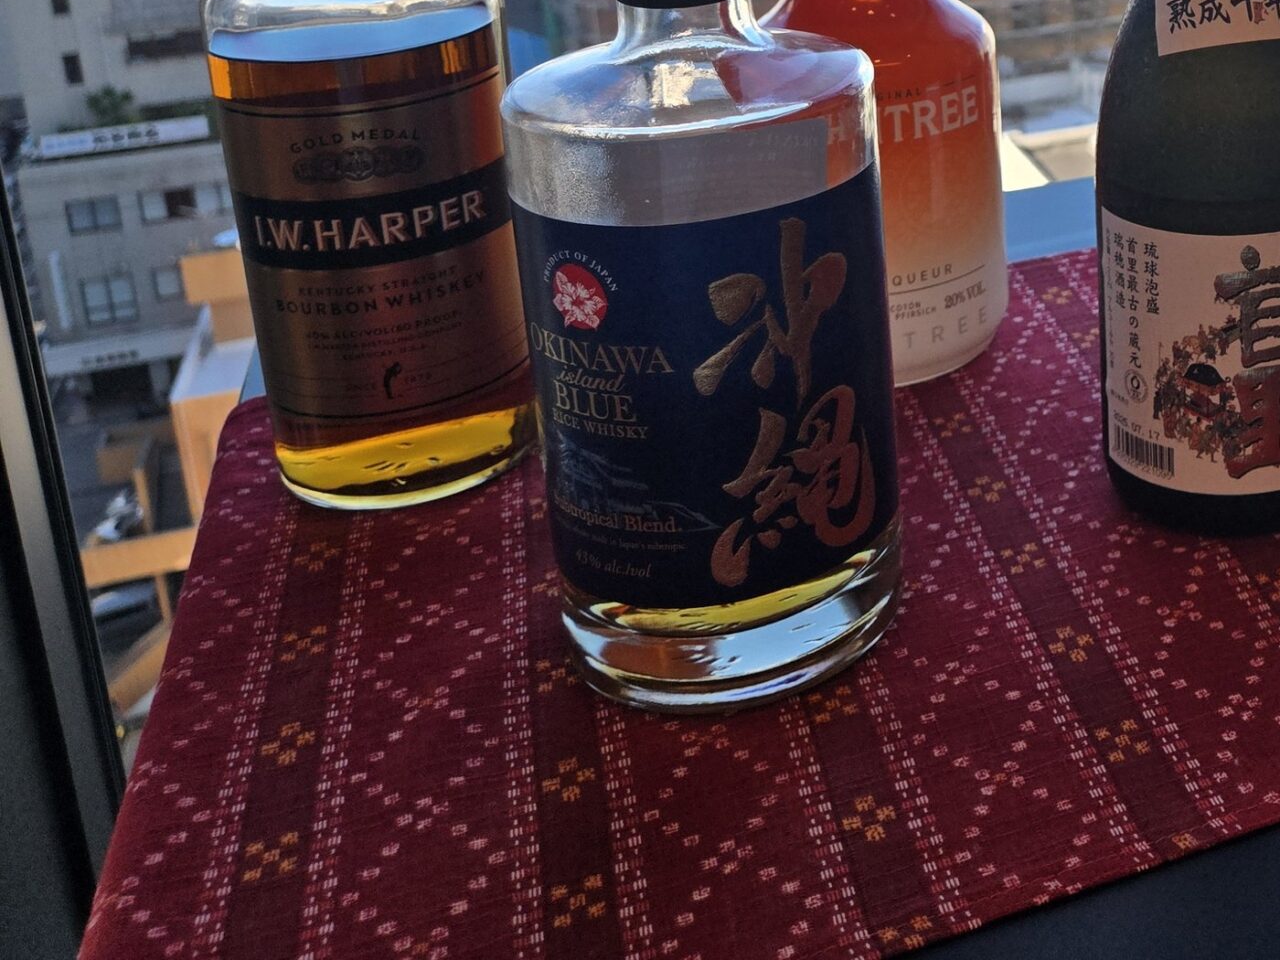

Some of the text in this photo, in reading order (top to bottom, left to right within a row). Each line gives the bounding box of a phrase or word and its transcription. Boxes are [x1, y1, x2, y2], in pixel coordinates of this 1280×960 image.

[291, 127, 422, 154] GOLD MEDAL
[574, 251, 589, 263] OF
[589, 258, 619, 292] JAPAN
[892, 263, 952, 286] QUEUR
[1143, 241, 1160, 315] 琉球泡盛
[275, 270, 485, 317] BOURBON WHISKEY
[530, 322, 675, 374] OKINAWA
[556, 365, 625, 392] island
[553, 379, 638, 423] BLUE
[584, 419, 649, 439] WHISKY
